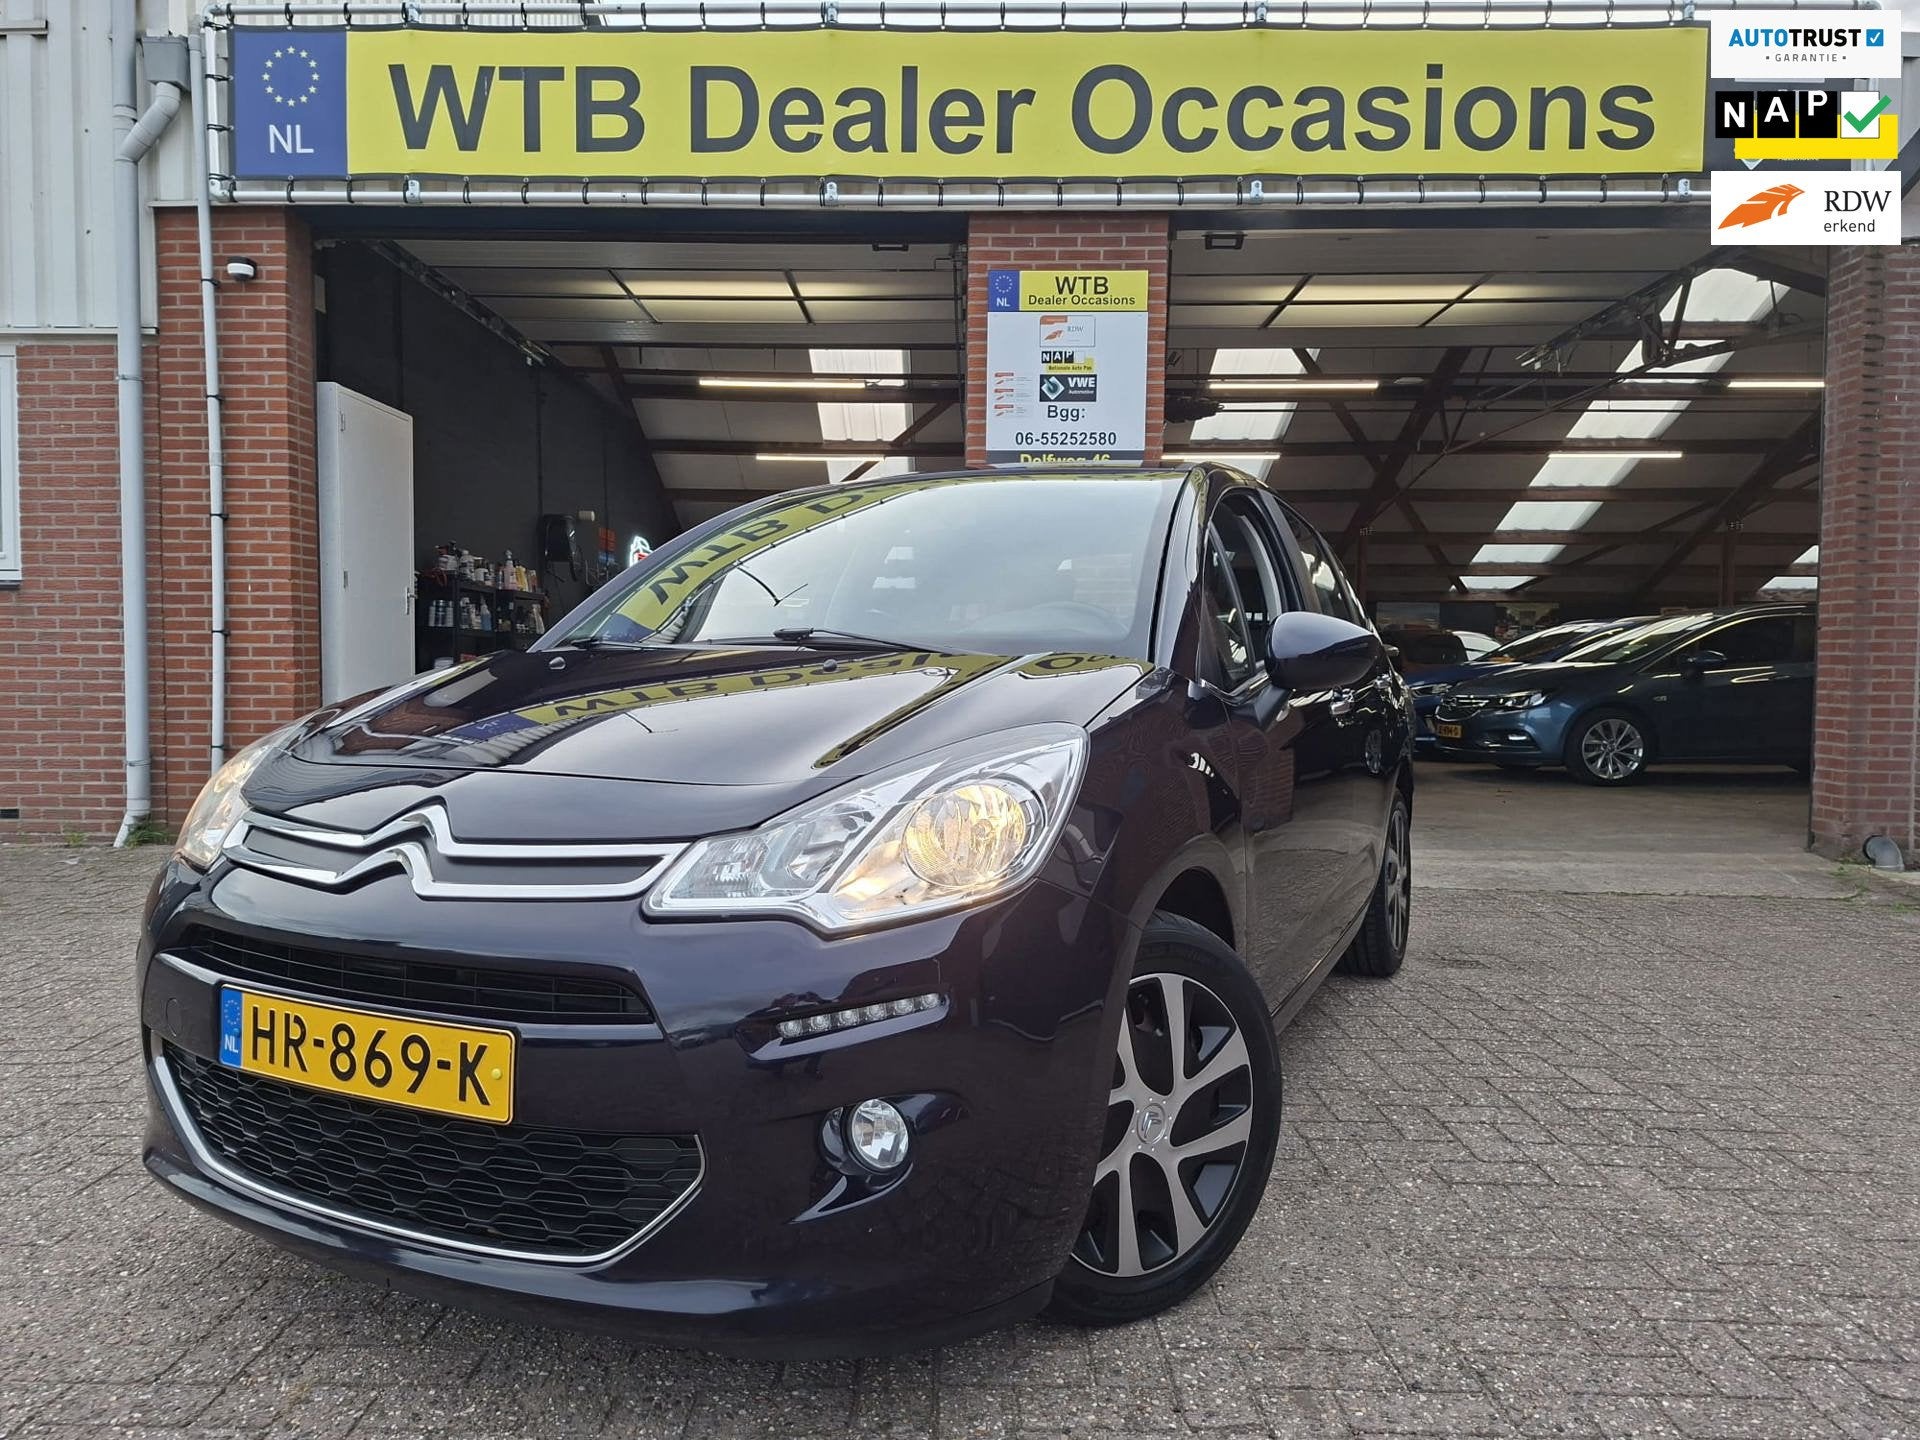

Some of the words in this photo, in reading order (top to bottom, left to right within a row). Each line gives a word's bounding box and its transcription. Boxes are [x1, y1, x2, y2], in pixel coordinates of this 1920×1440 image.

[388, 64, 646, 153] WTB
[690, 63, 1036, 155] Dealer
[1070, 63, 1656, 155] Occasions
[269, 124, 314, 154] NL
[1055, 276, 1109, 295] WTB
[996, 297, 1010, 307] NL
[1028, 295, 1066, 306] Dealer
[1071, 295, 1136, 306] Occasions
[1042, 350, 1073, 362] NAP
[1067, 377, 1095, 388] VWE
[1047, 405, 1085, 422] Bgg:
[1015, 432, 1117, 446] 06-55252580
[224, 1033, 239, 1054] NL
[251, 1005, 491, 1107] HR-869-K
